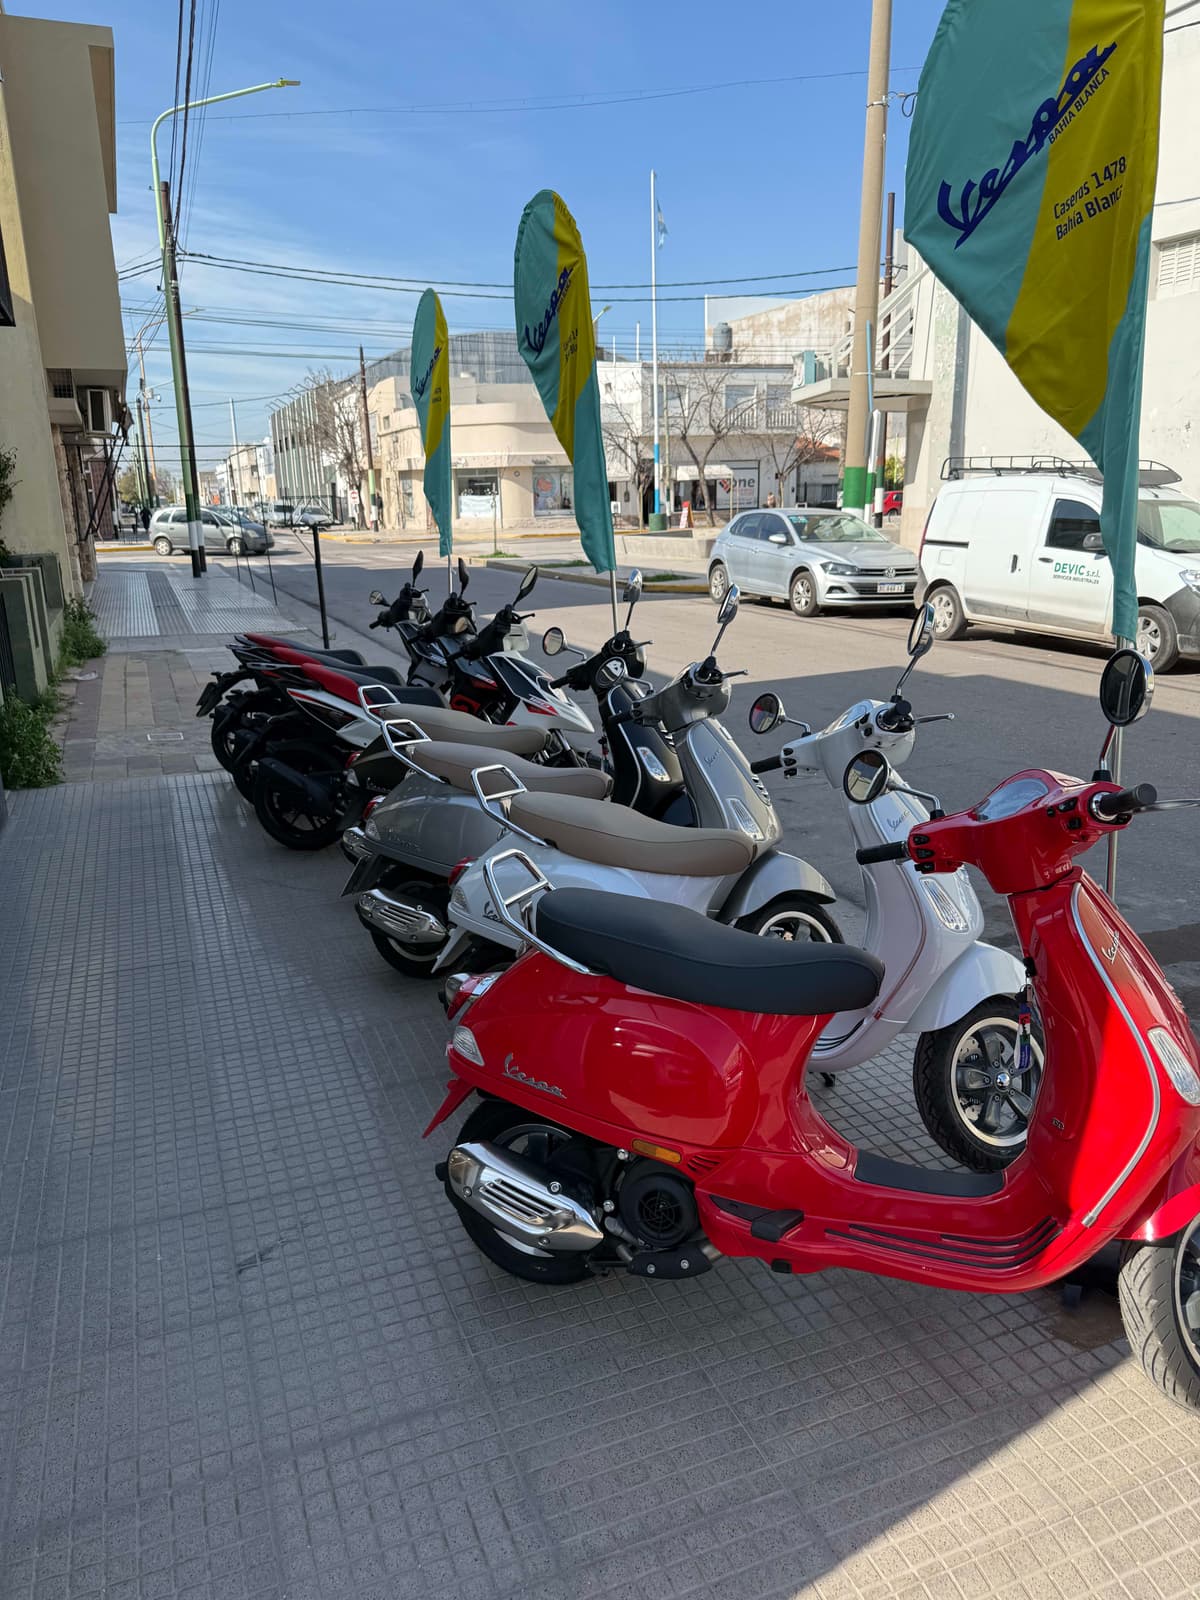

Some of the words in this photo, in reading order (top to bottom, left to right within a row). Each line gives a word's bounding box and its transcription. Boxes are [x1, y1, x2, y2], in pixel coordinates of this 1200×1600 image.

[1048, 110, 1076, 144] BAHIA
[1074, 68, 1110, 112] BLANCA
[937, 41, 1117, 250] Vespa
[1054, 181, 1090, 219] Caseros
[1091, 156, 1126, 189] 1478
[1054, 562, 1086, 576] DEVIC
[501, 1052, 568, 1100] Vespa
